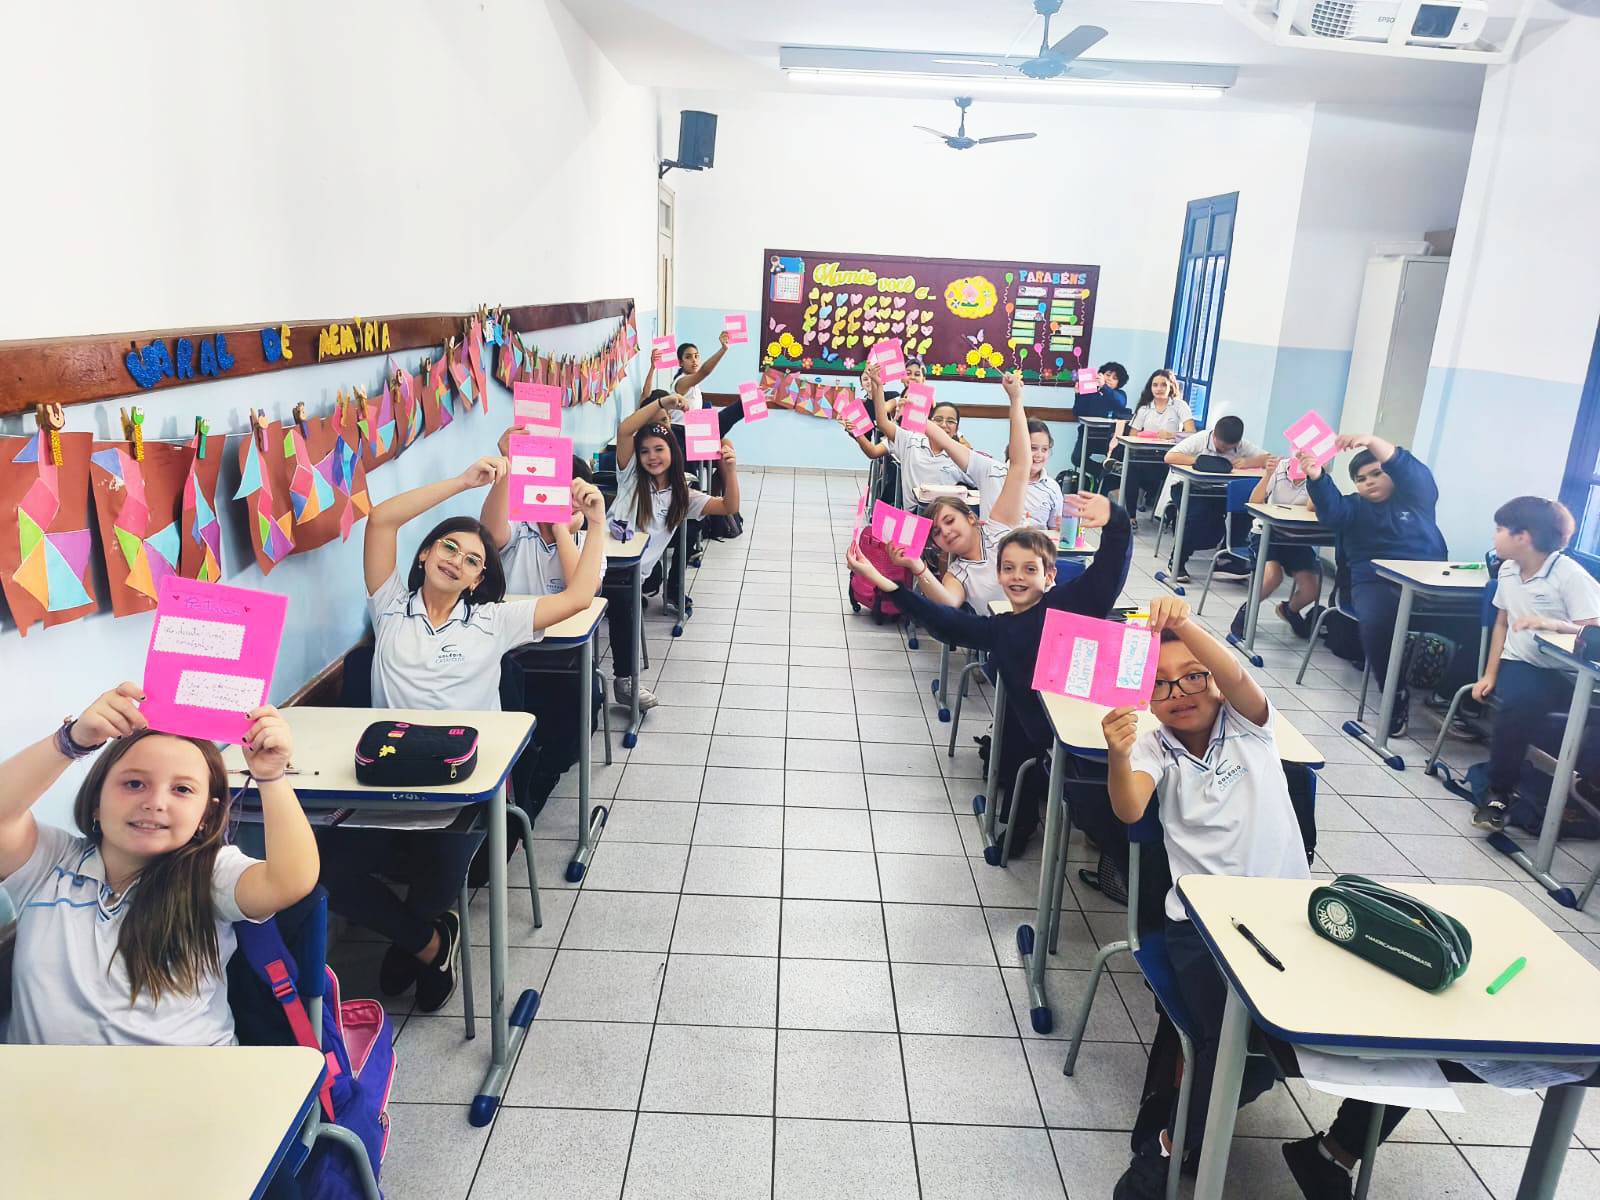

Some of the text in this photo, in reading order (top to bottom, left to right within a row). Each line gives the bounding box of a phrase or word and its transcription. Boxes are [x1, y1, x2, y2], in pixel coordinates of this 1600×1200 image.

[126, 333, 235, 389] VARAL
[261, 323, 293, 363] DE
[1317, 908, 1355, 940] PALMEIRAS
